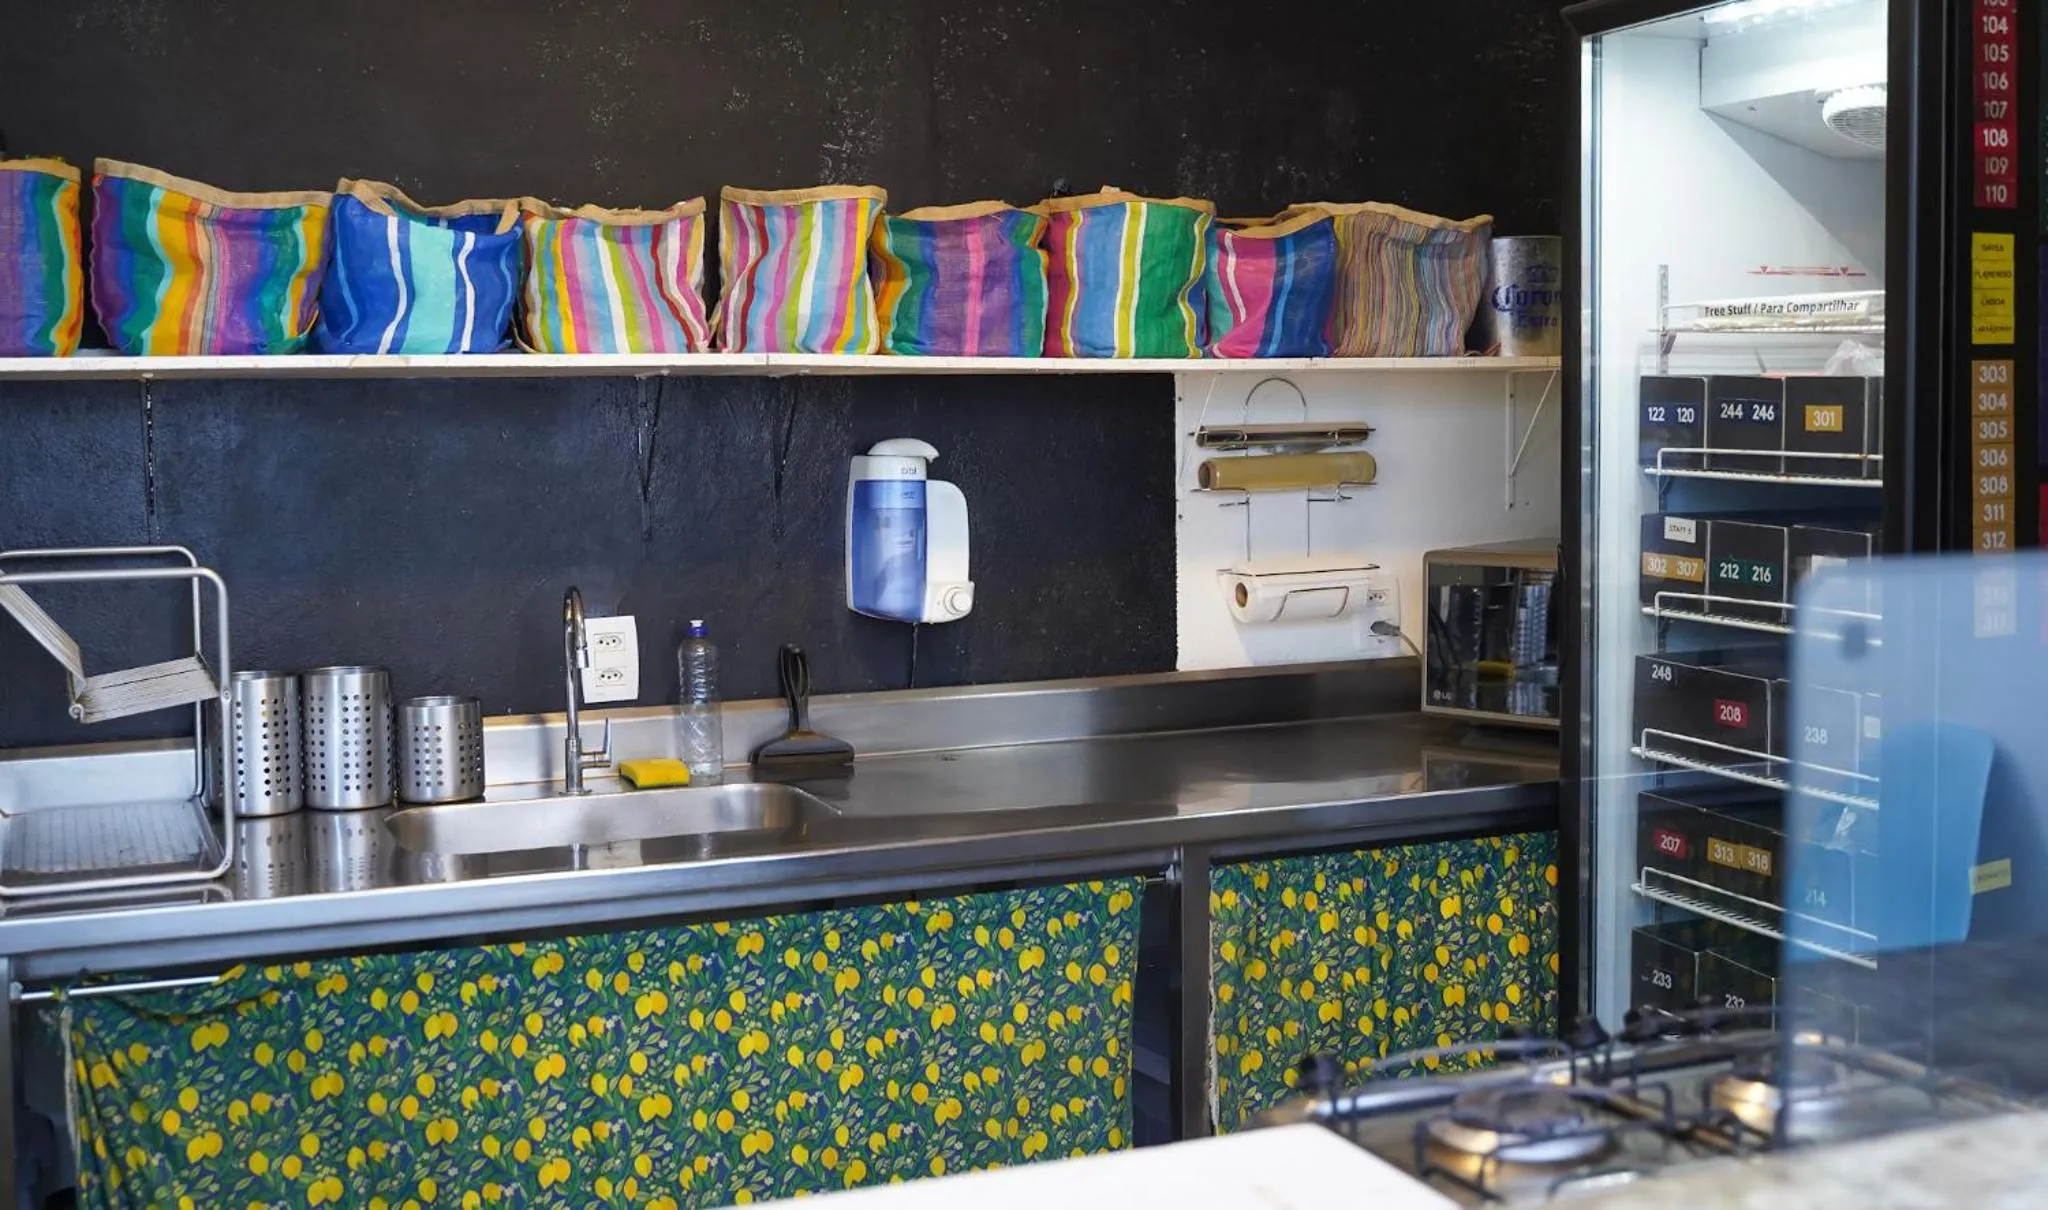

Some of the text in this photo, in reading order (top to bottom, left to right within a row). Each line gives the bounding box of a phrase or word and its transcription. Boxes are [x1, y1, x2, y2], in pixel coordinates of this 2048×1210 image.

[1982, 16, 2008, 34] 104
[1983, 44, 2009, 62] 105
[1983, 72, 2009, 90] 106
[1984, 101, 2008, 119] 107
[1983, 129, 2008, 147] 108
[1985, 157, 2009, 175] 109
[1985, 185, 2007, 203] 110
[1704, 306, 1726, 317] Free
[1727, 303, 1751, 316] Stuff
[1760, 302, 1784, 315] Para
[1786, 299, 1861, 315] Compartilhar
[1979, 366, 2007, 383] 303
[1978, 393, 2007, 411] 304
[1648, 407, 1694, 423] 122 120
[1721, 403, 1775, 421] 244 246
[1813, 410, 1835, 427] 301
[1979, 421, 2007, 438] 305
[1979, 449, 2007, 466] 306
[1979, 477, 2008, 494] 308
[1983, 504, 2005, 522] 311
[1982, 532, 2006, 550] 312
[1647, 557, 1698, 578] 302 307
[1720, 563, 1772, 583] 212 216
[1651, 664, 1672, 681] 248
[1720, 705, 1742, 722] 208
[1804, 725, 1828, 744] 238
[1660, 834, 1681, 852] 207
[1714, 844, 1734, 863] 313
[1652, 969, 1672, 989] 233
